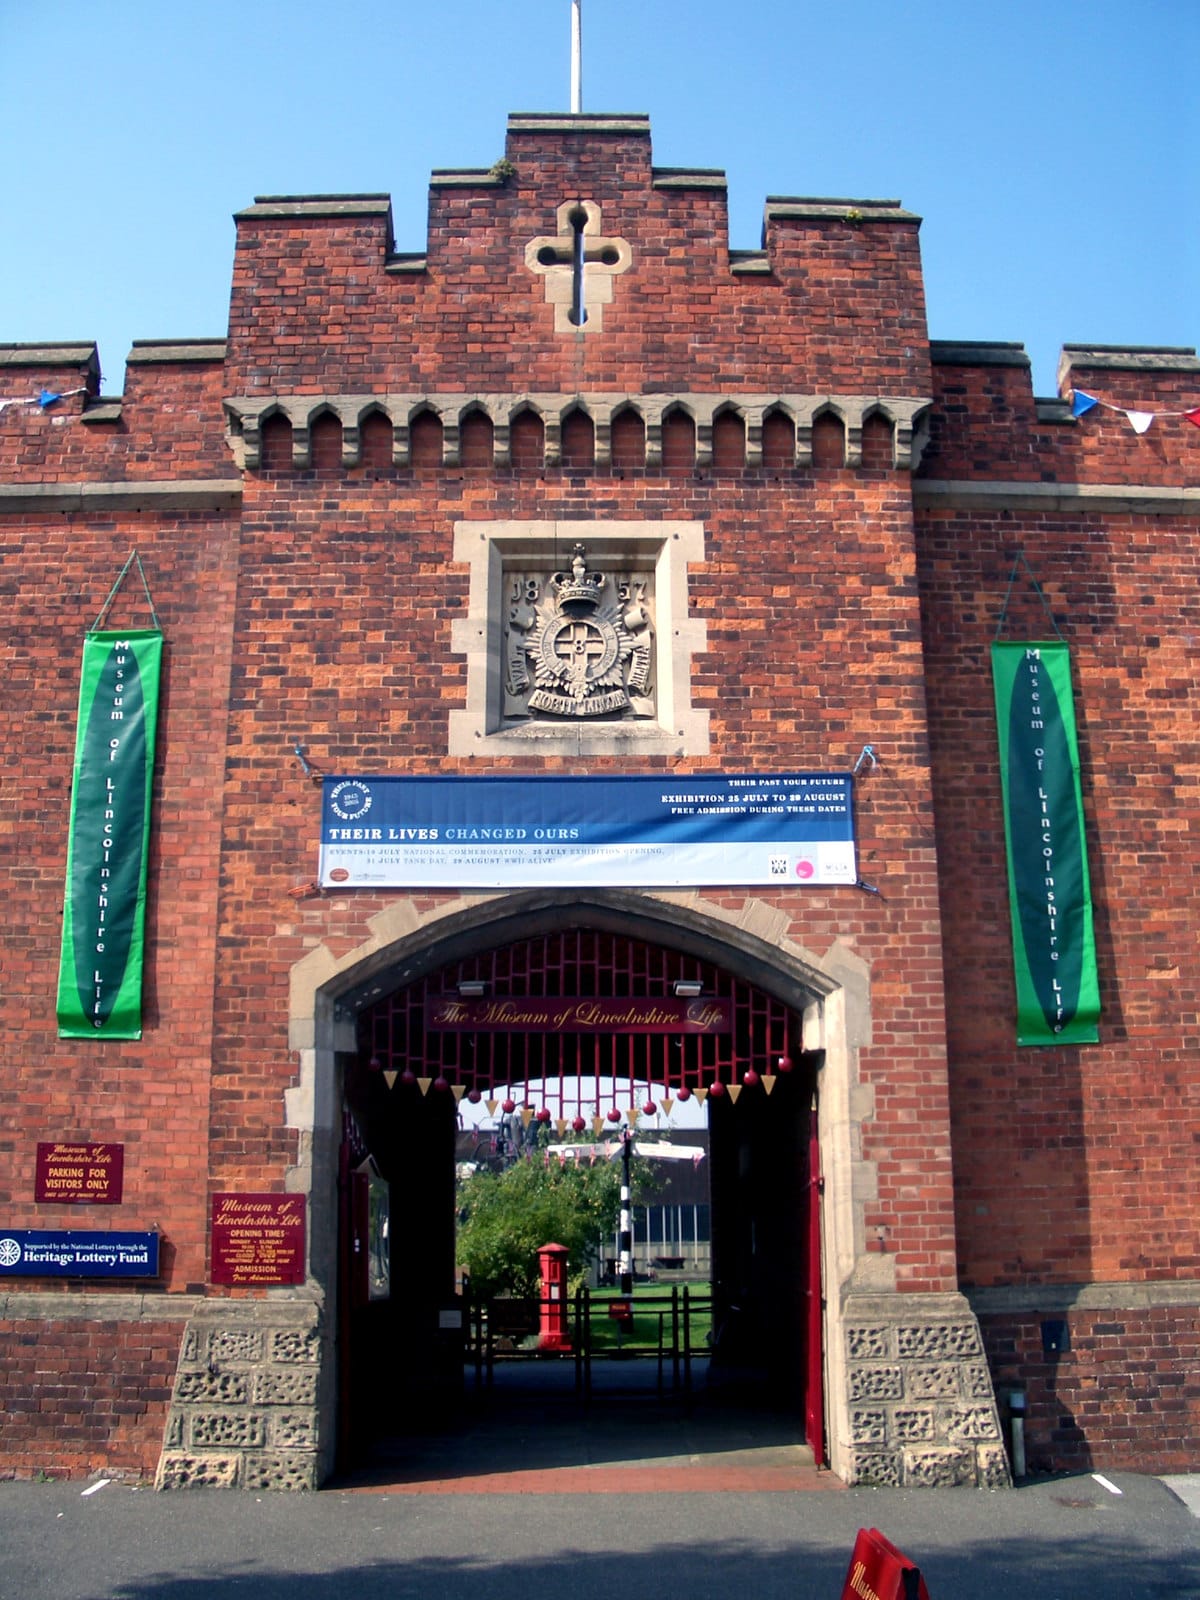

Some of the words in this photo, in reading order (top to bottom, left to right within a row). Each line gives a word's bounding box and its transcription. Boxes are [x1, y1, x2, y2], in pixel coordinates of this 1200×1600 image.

[574, 639, 586, 654] 8
[110, 640, 130, 720] Museum
[1026, 648, 1044, 729] Museum
[109, 738, 120, 762] of
[1034, 747, 1045, 771] of
[330, 780, 352, 799] THEIR
[352, 780, 370, 794] PAST
[661, 795, 725, 803] EXHIBITION
[743, 794, 769, 802] JULY
[772, 794, 787, 802] TO
[804, 793, 846, 801] AUGUST
[331, 802, 349, 820] YOUR
[349, 796, 373, 820] FUTURE
[697, 806, 746, 814] ADMISSION
[329, 828, 383, 840] THEIR
[388, 828, 439, 840] LIVES
[445, 828, 527, 840] CHANGED
[534, 828, 580, 839] OURS
[570, 848, 620, 856] EXHIBITION
[96, 777, 116, 953] Lincolnshire
[1038, 786, 1060, 961] Lincolnshire
[93, 970, 103, 1028] Life
[1052, 978, 1064, 1033] Life
[433, 1002, 468, 1023] The
[473, 1001, 549, 1024] Museum
[553, 1006, 573, 1031] of
[573, 1001, 680, 1026] Lincolnshire
[686, 1001, 723, 1031] Life
[53, 1144, 87, 1154] Museum
[92, 1145, 106, 1157] of
[44, 1153, 93, 1163] Lincolnshire
[94, 1154, 112, 1164] Life
[48, 1167, 84, 1178] PARKING
[89, 1168, 106, 1178] FOR
[45, 1178, 83, 1189] VISITORS
[86, 1179, 109, 1190] ONLY
[221, 1198, 273, 1212] Museum
[277, 1200, 295, 1215] of
[214, 1213, 279, 1226] Lincolnshire
[280, 1213, 302, 1226] Life
[230, 1229, 262, 1237] OPENING
[264, 1230, 285, 1238] TIMES
[24, 1243, 53, 1251] Supported
[53, 1243, 60, 1252] by
[95, 1244, 115, 1252] Lottery
[116, 1244, 138, 1252] through
[24, 1251, 74, 1266] Heritage
[75, 1252, 118, 1267] Lottery
[119, 1252, 148, 1263] Fund
[234, 1265, 276, 1273] ADMISSION
[232, 1273, 247, 1282] Free
